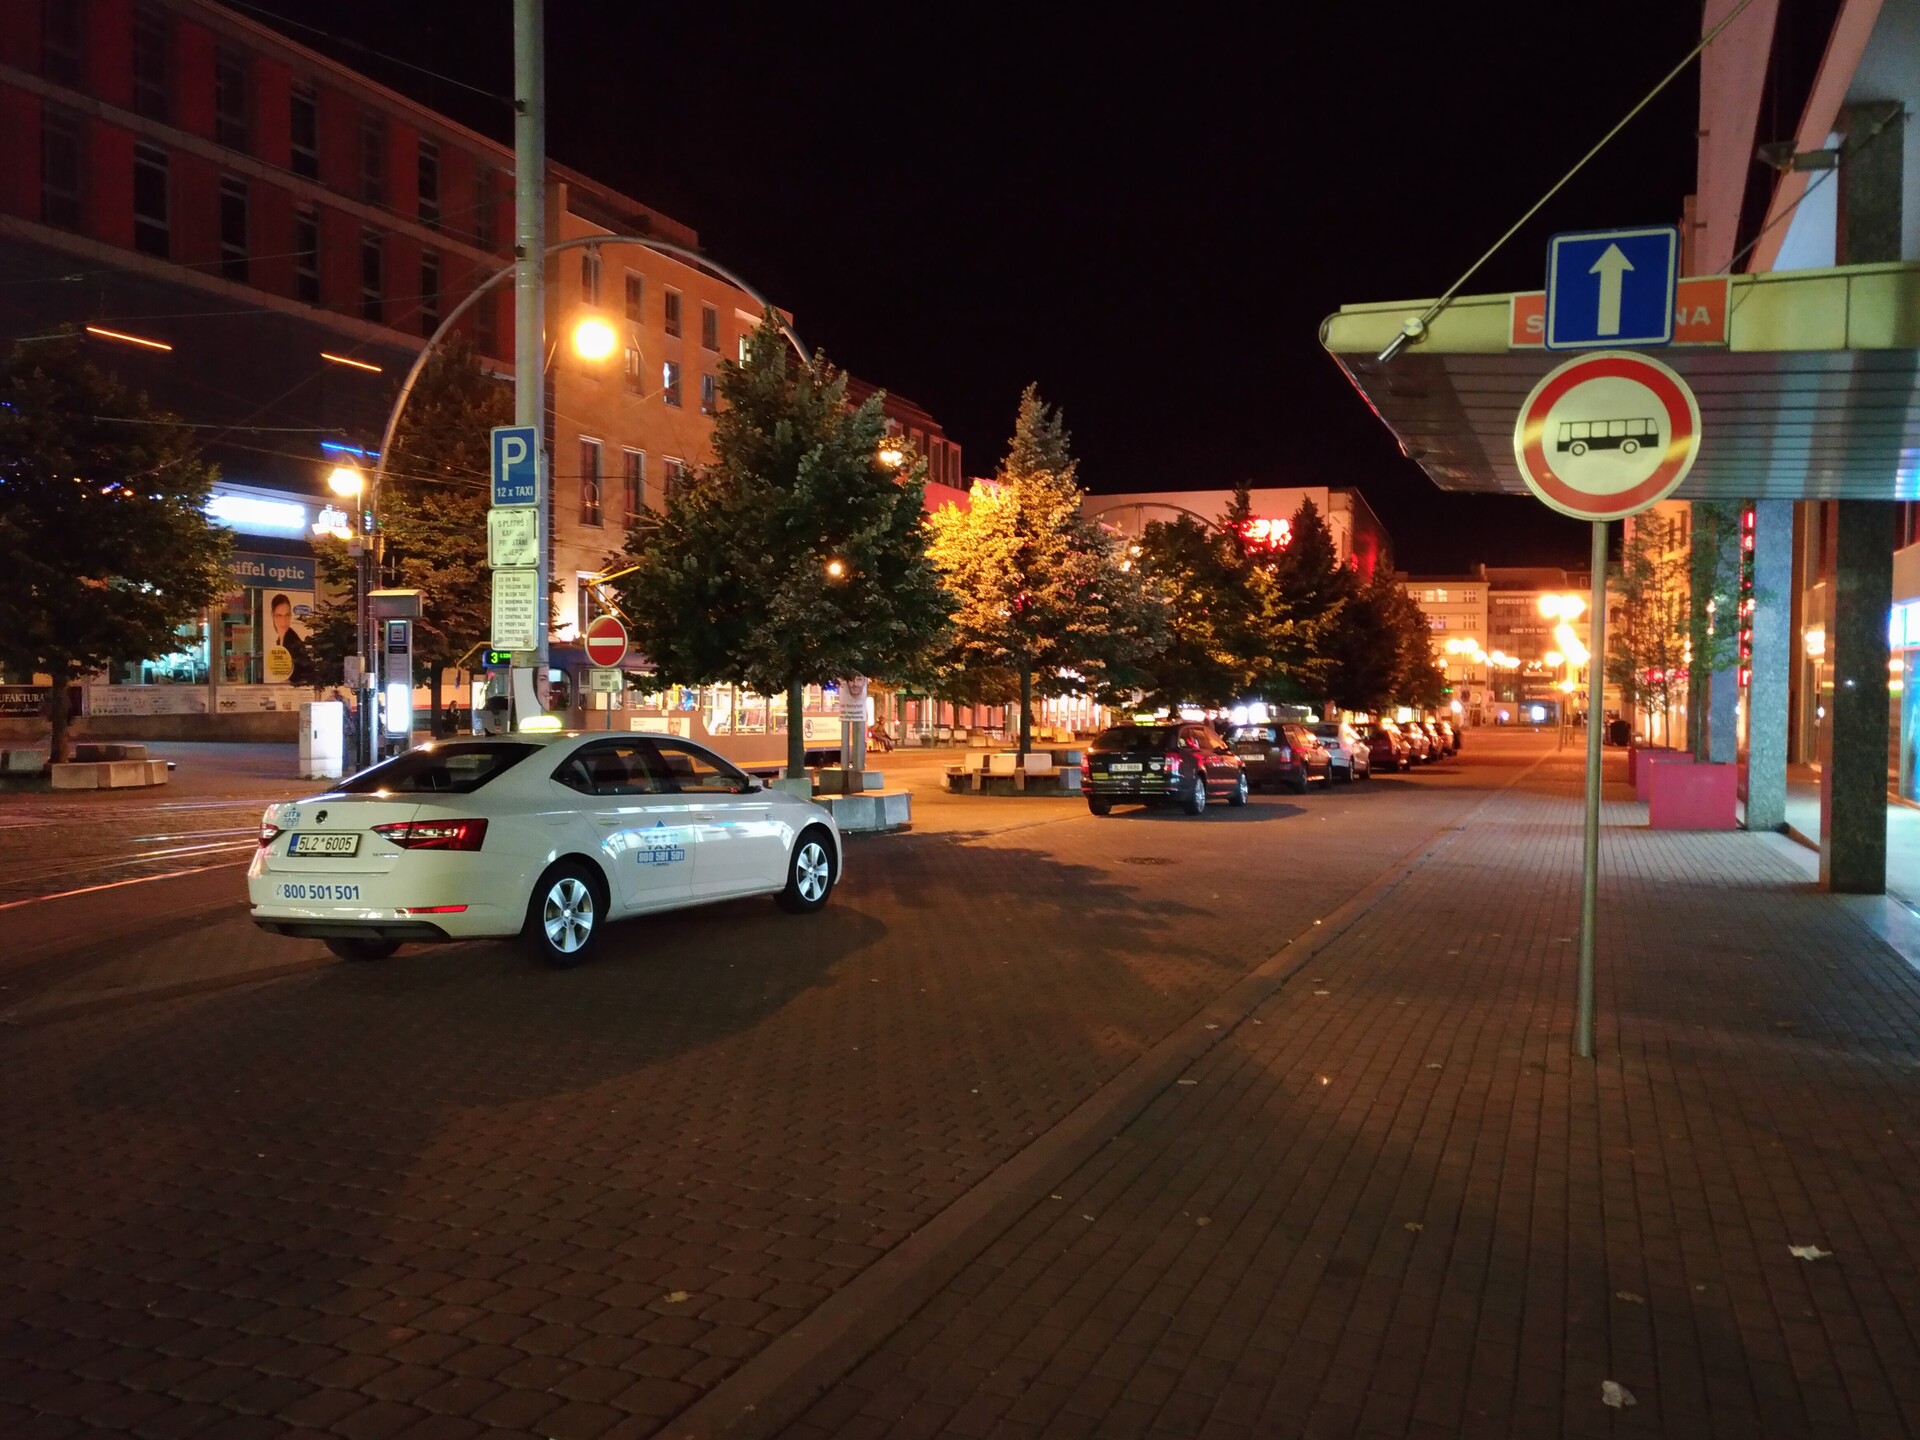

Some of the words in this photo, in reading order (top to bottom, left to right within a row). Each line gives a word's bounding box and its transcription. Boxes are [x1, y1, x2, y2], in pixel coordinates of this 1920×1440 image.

[502, 436, 527, 481] P
[496, 487, 507, 497] 12
[508, 488, 513, 497] x
[515, 486, 534, 497] TAXI
[268, 566, 305, 581] optic
[491, 652, 498, 663] 3
[298, 837, 319, 851] 5L2
[325, 837, 353, 851] 6005
[638, 852, 654, 862] 800
[655, 852, 668, 861] 501
[670, 850, 684, 860] 501
[284, 884, 306, 899] 800
[309, 885, 332, 900] 501
[335, 885, 360, 900] 501
